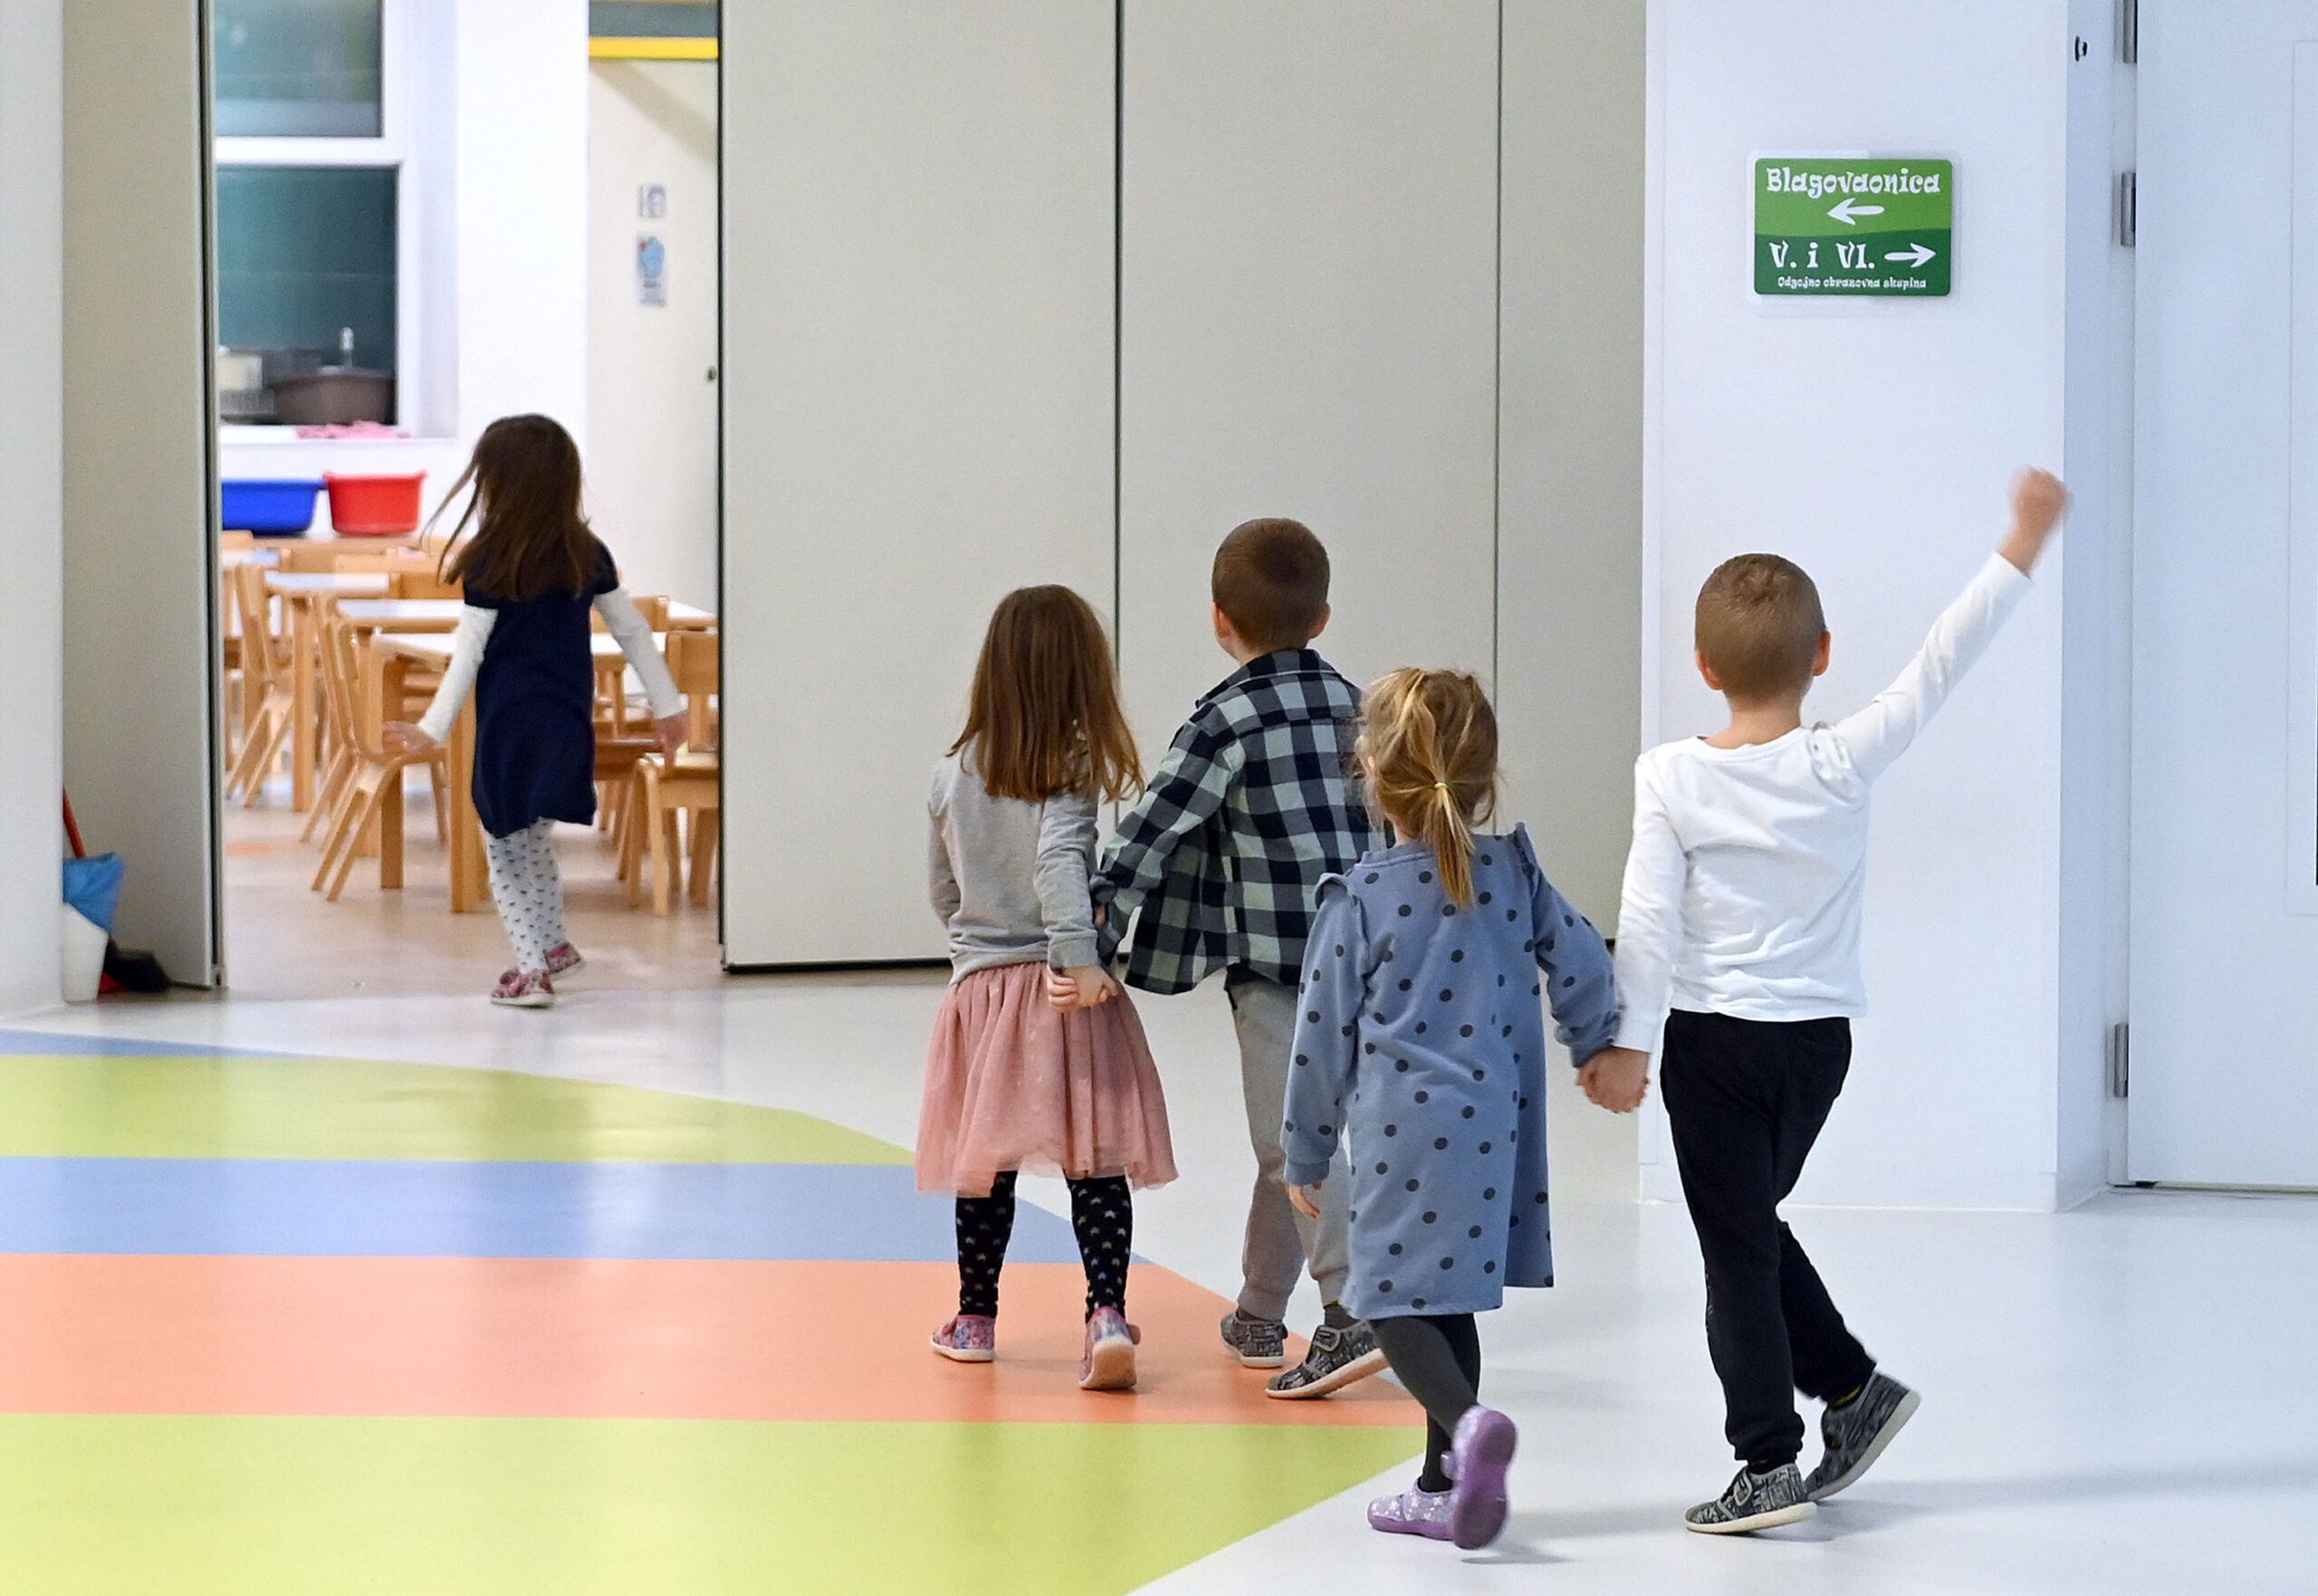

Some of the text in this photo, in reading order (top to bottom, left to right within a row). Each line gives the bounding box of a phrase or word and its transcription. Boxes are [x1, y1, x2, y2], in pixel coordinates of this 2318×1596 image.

[1766, 167, 1940, 198] Blagovaonica
[1769, 240, 1875, 269] V. i VI.
[1777, 276, 1927, 290] Odgojno obrazovna skupina
